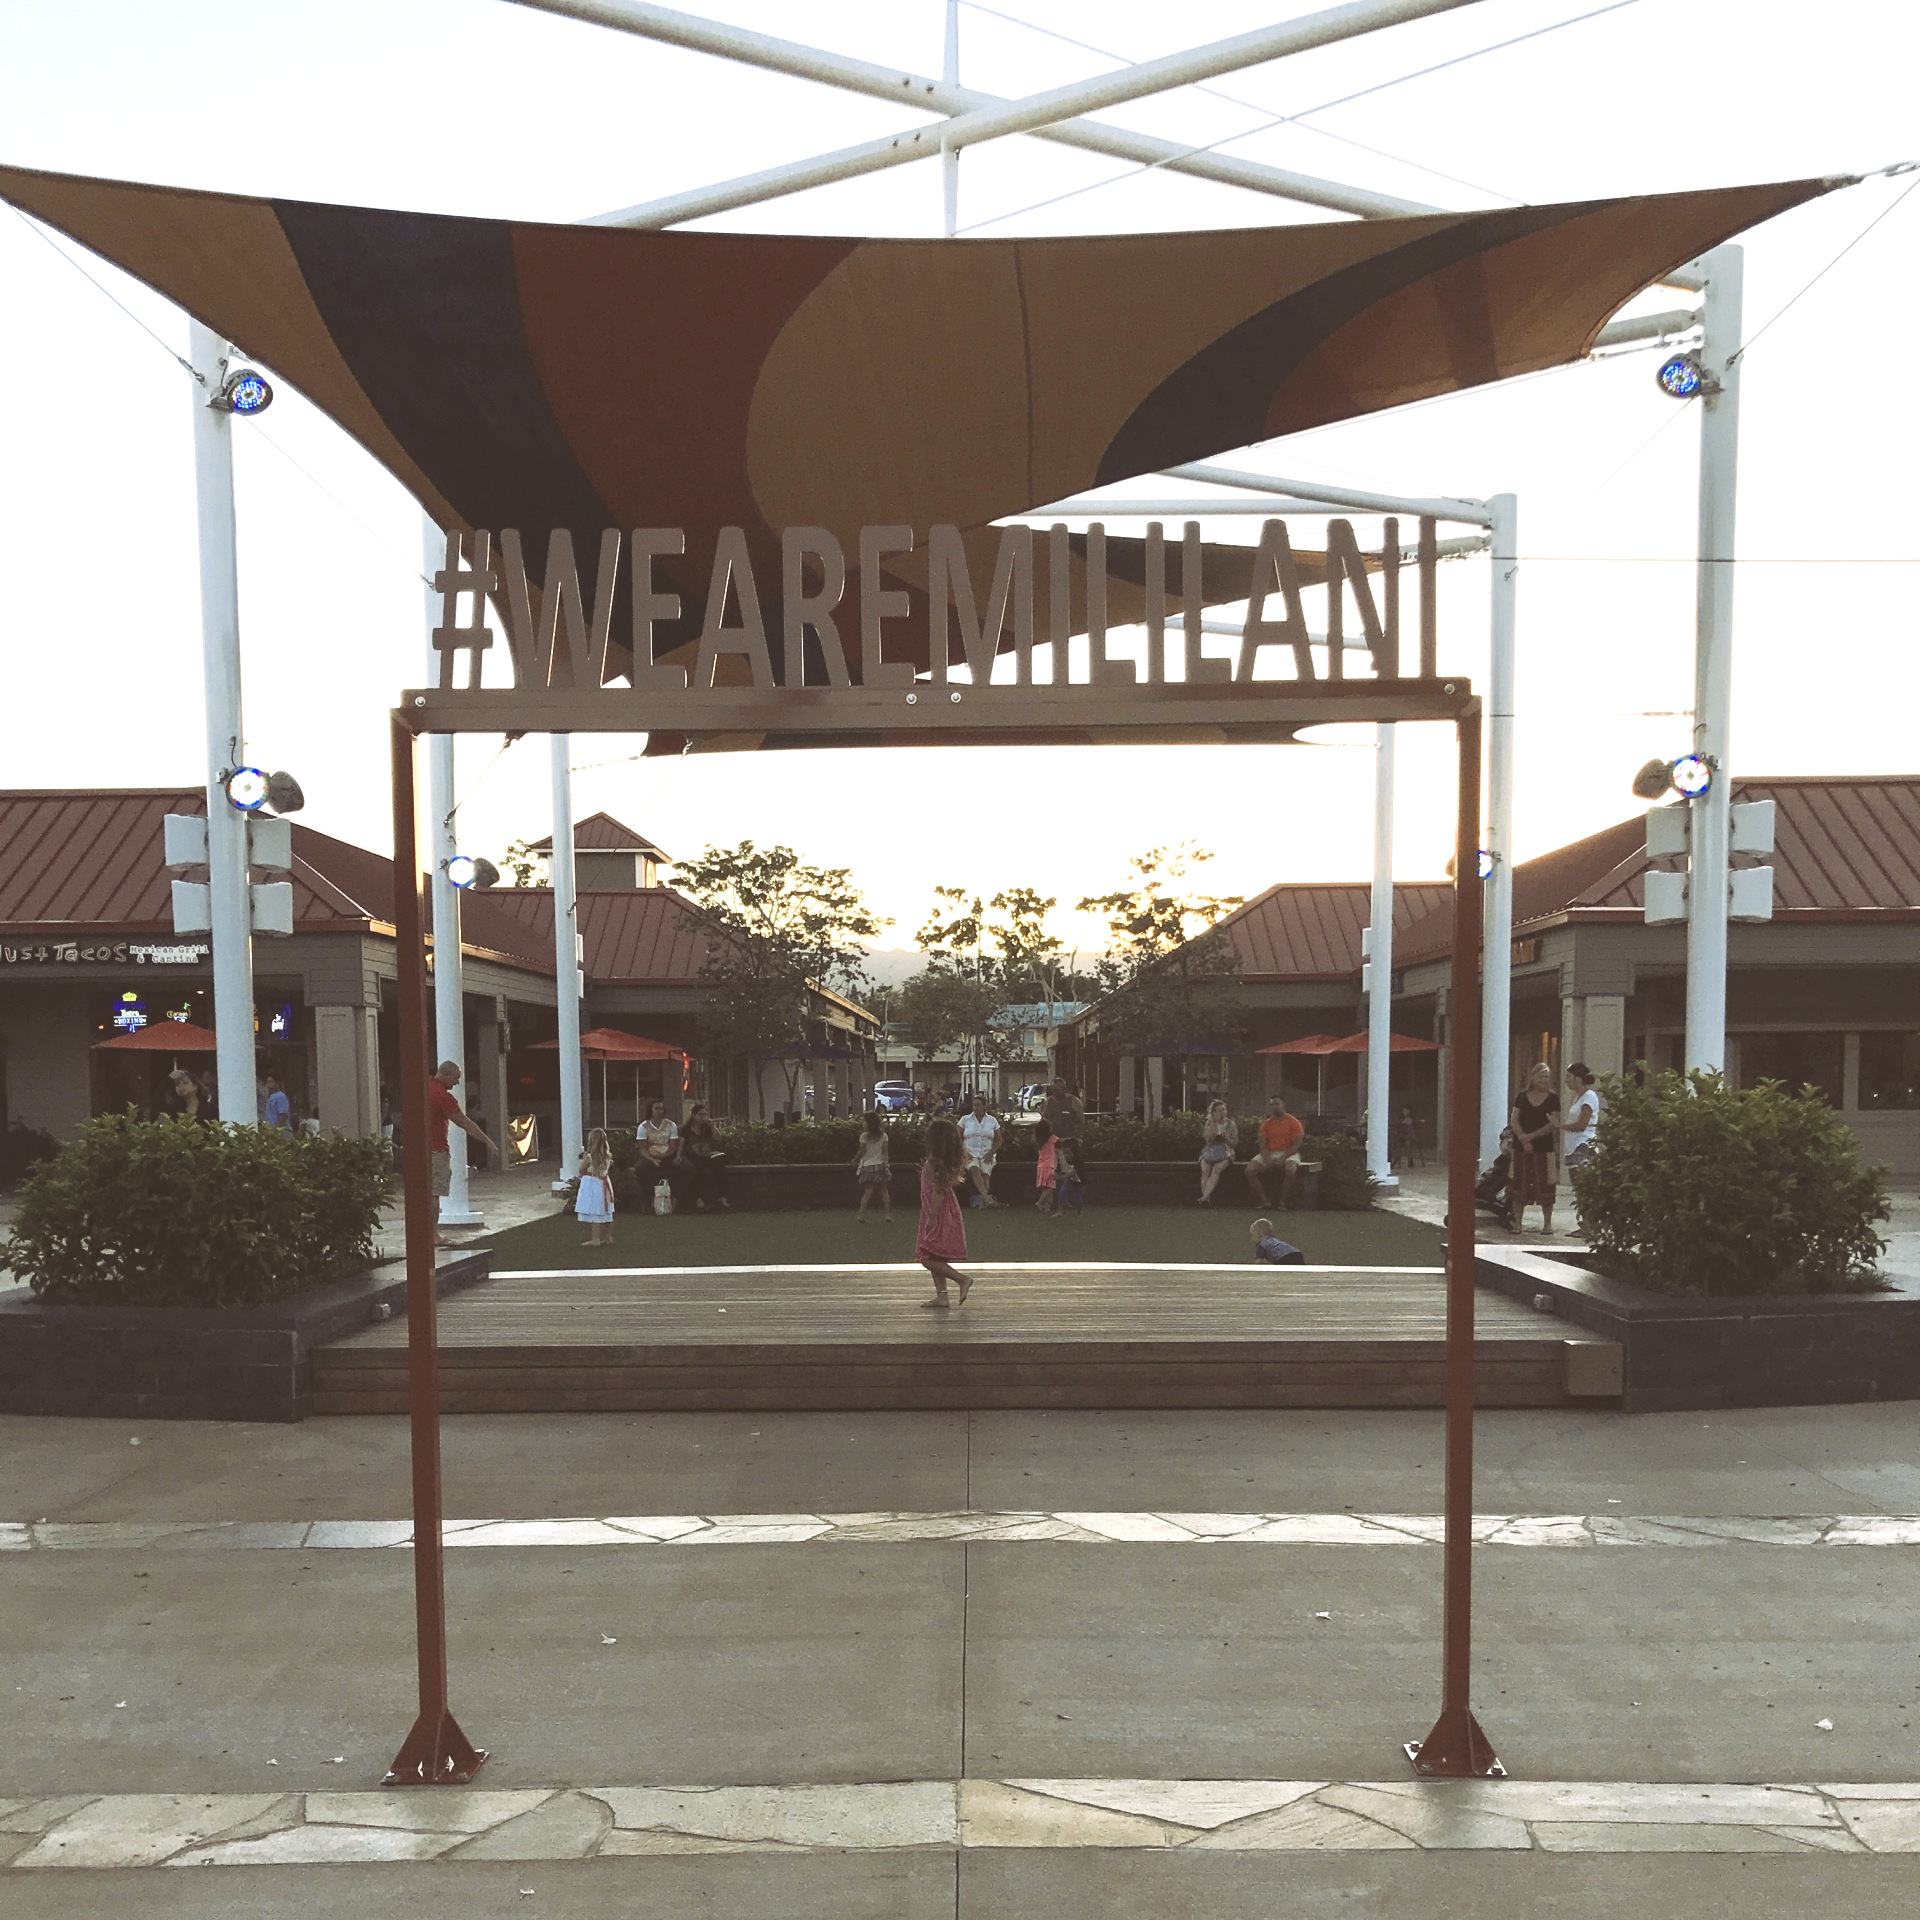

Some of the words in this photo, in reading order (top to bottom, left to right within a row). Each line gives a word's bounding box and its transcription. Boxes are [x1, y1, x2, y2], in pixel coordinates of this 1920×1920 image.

[433, 514, 1437, 690] #WEAREMILILANI
[0, 944, 48, 963] ust
[129, 945, 175, 954] Mexican
[178, 944, 209, 954] Grill
[152, 953, 198, 963] Cantina
